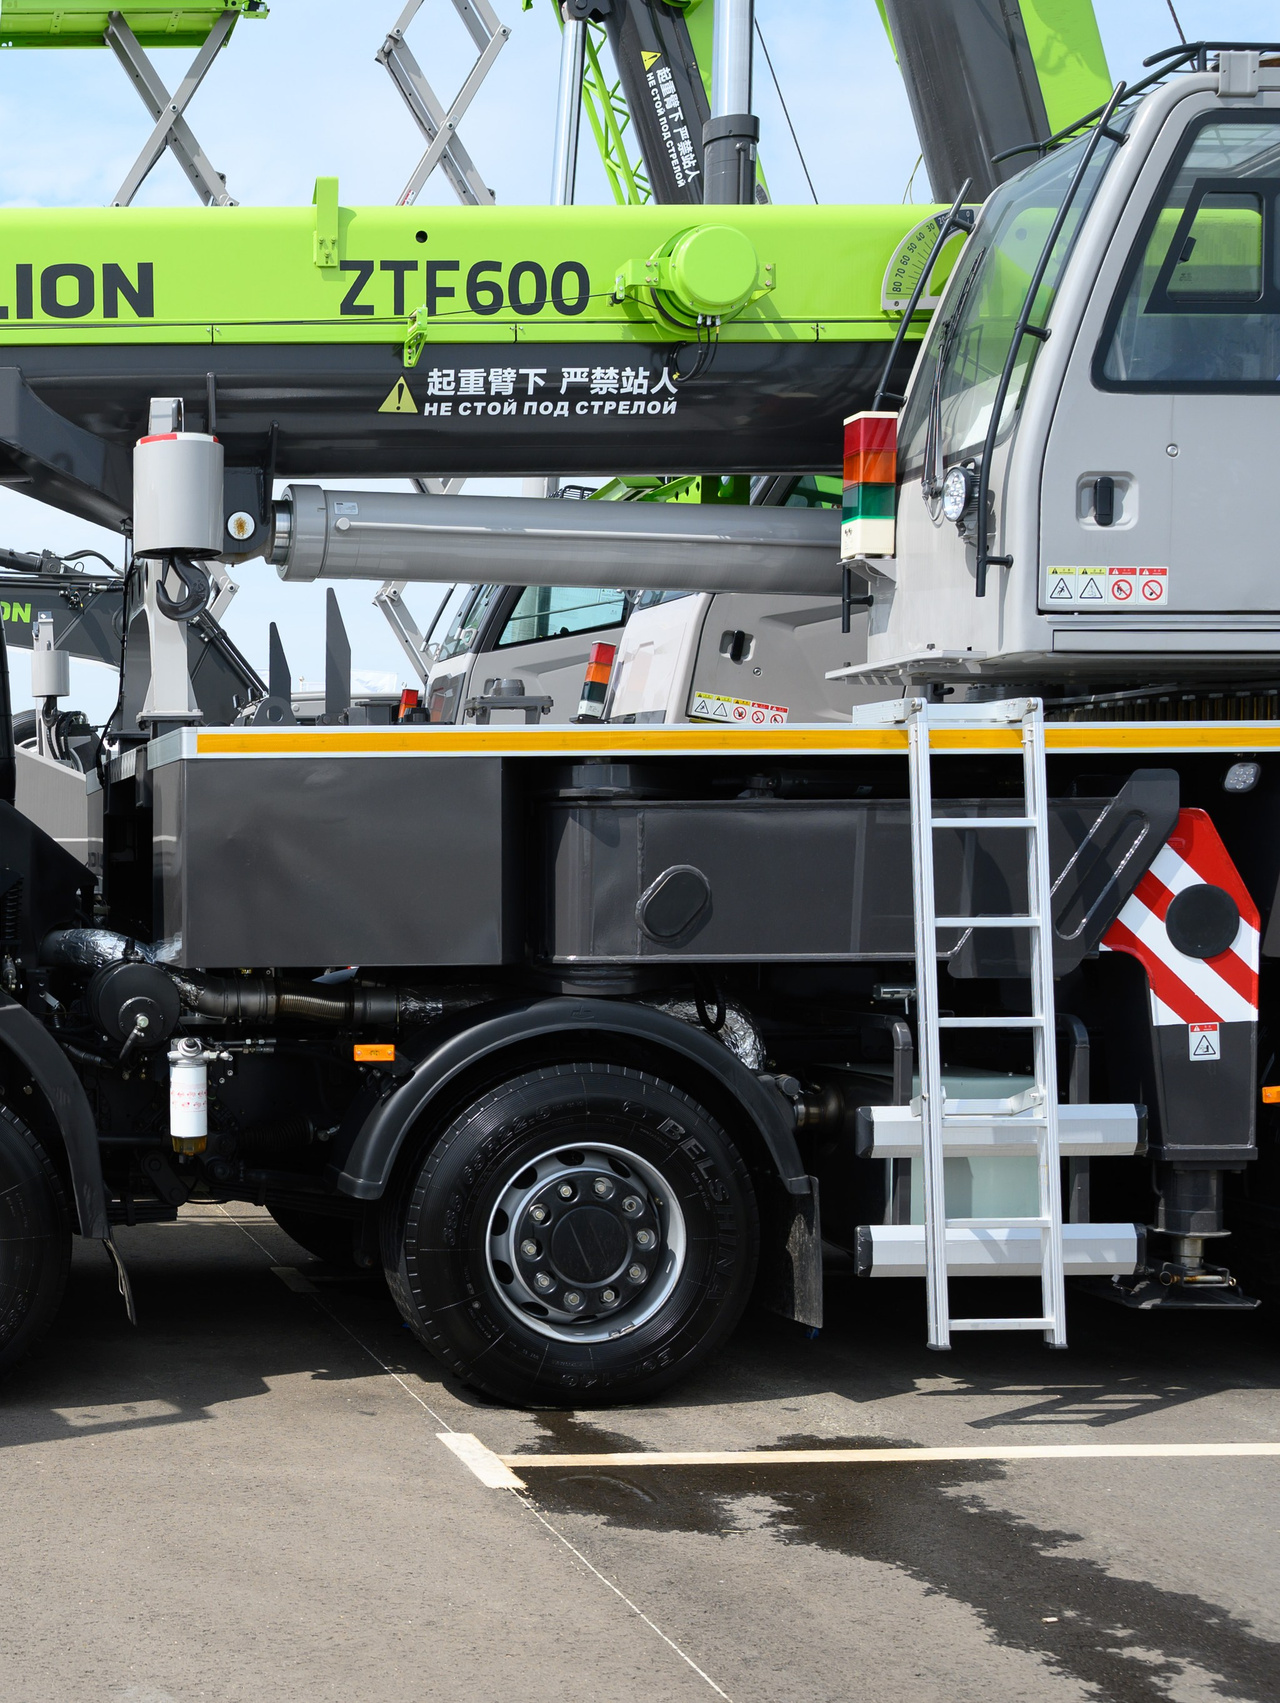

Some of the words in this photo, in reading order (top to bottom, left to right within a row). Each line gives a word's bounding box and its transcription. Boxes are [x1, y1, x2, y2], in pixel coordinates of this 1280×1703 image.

[646, 72, 657, 88] НЕ
[650, 88, 666, 116] СТОЙ
[659, 117, 672, 141] ПОД
[666, 140, 687, 188] СТРЕЛОЙ
[926, 222, 936, 232] 30
[916, 232, 925, 242] 40
[907, 242, 917, 253] 50
[900, 255, 910, 266] 60
[895, 268, 905, 278] 70
[339, 260, 590, 316] ZTF600
[892, 282, 902, 292] 80
[426, 367, 548, 396] 起重臂下
[559, 366, 679, 396] 严禁站人
[423, 402, 453, 416] НЕ
[458, 398, 518, 416] СТОЙ
[522, 401, 570, 418] ПОД
[574, 397, 678, 415] СТРЕЛОЙ
[656, 1116, 736, 1301] BELSHINA
